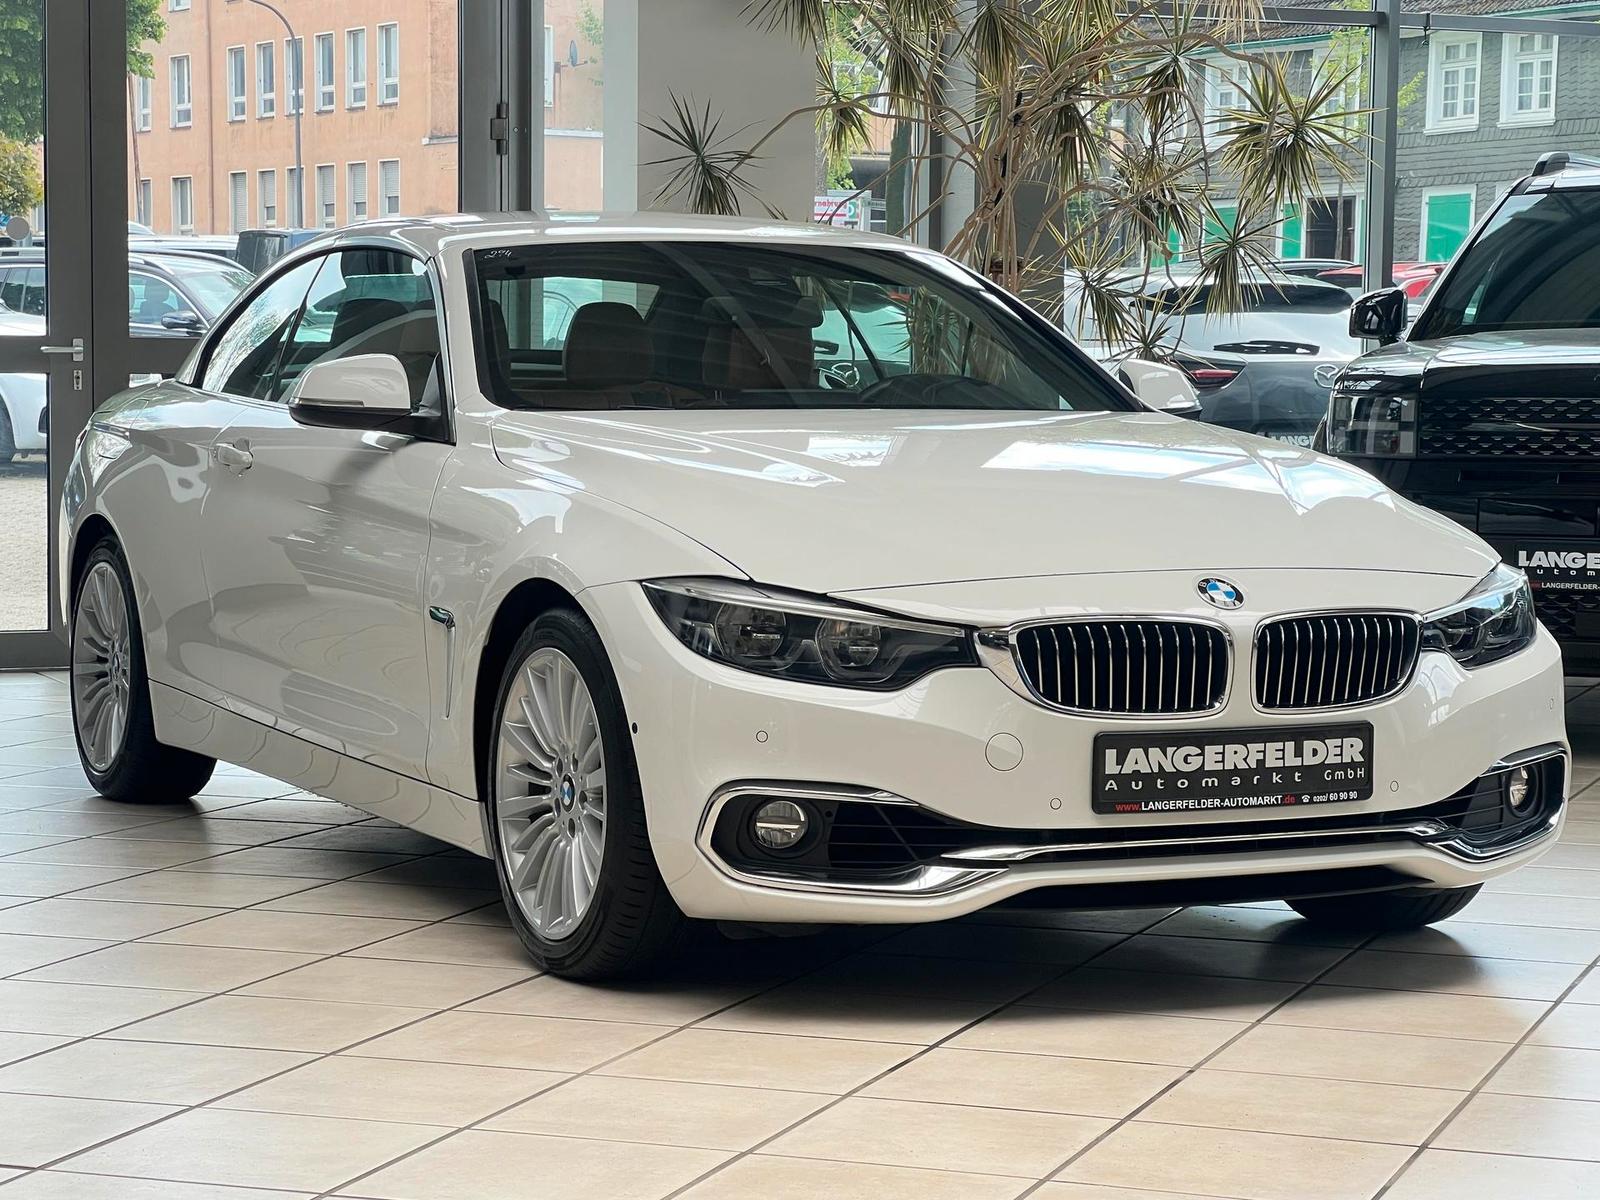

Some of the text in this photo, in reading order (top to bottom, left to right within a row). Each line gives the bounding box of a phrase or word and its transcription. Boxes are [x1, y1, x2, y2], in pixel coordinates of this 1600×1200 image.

[1105, 737, 1364, 774] LANGERFELDER
[1105, 767, 1365, 791] Automarkt GmbH
[1329, 792, 1338, 801] 60
[1339, 791, 1348, 800] 90
[1349, 790, 1358, 799] 90
